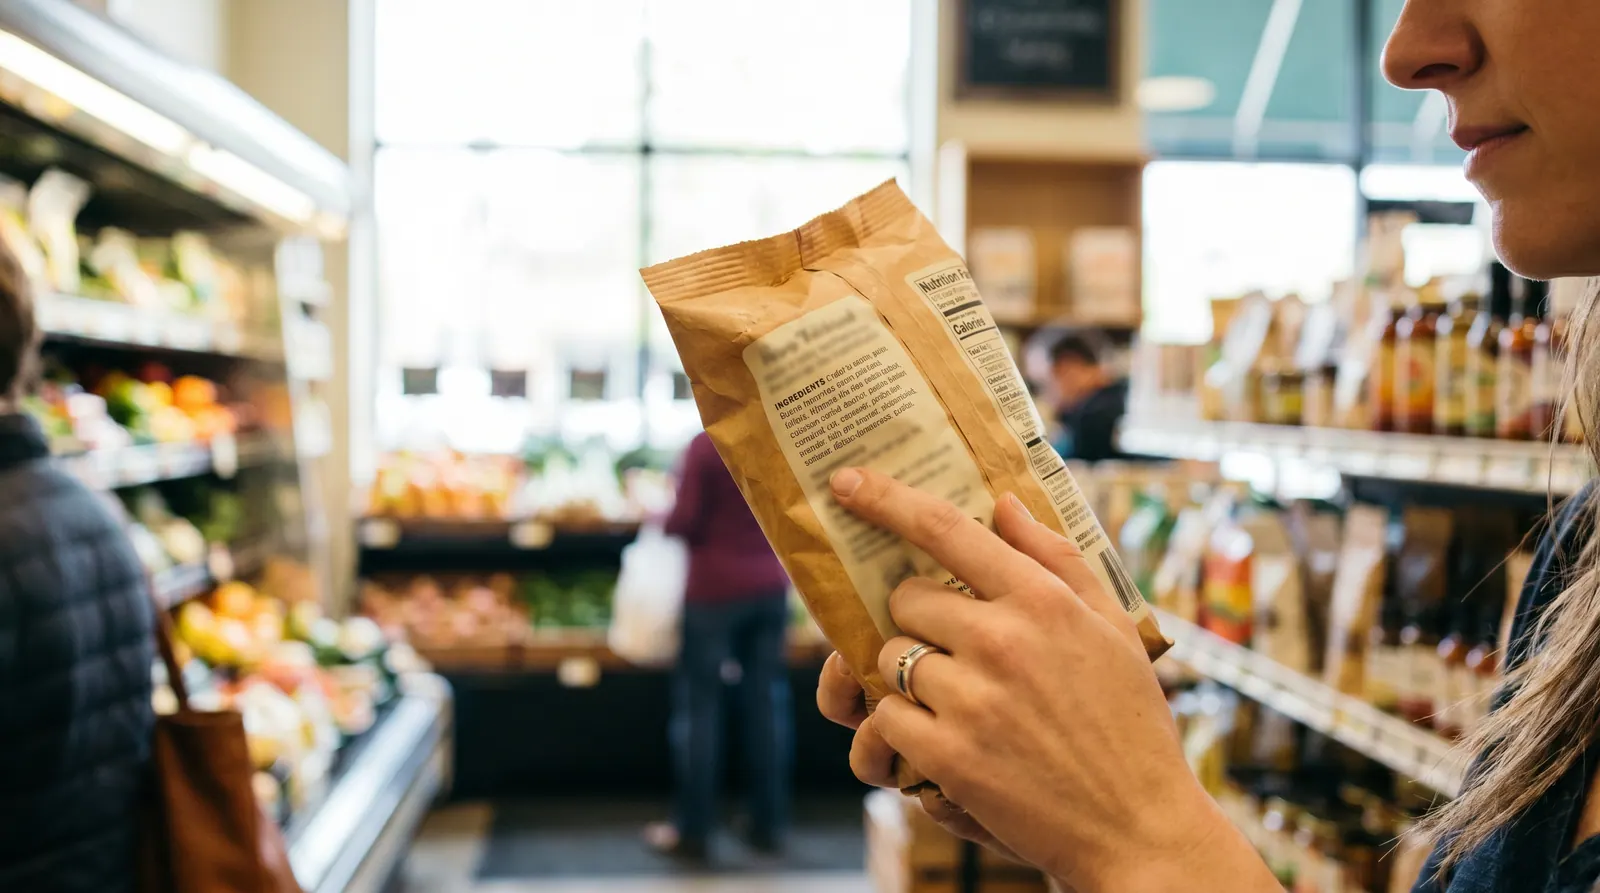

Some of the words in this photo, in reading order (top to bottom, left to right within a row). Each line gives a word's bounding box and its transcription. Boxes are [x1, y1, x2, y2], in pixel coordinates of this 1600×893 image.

[919, 272, 960, 293] Nutrition
[953, 317, 986, 335] Calories
[775, 378, 826, 411] INGREDIENTS
